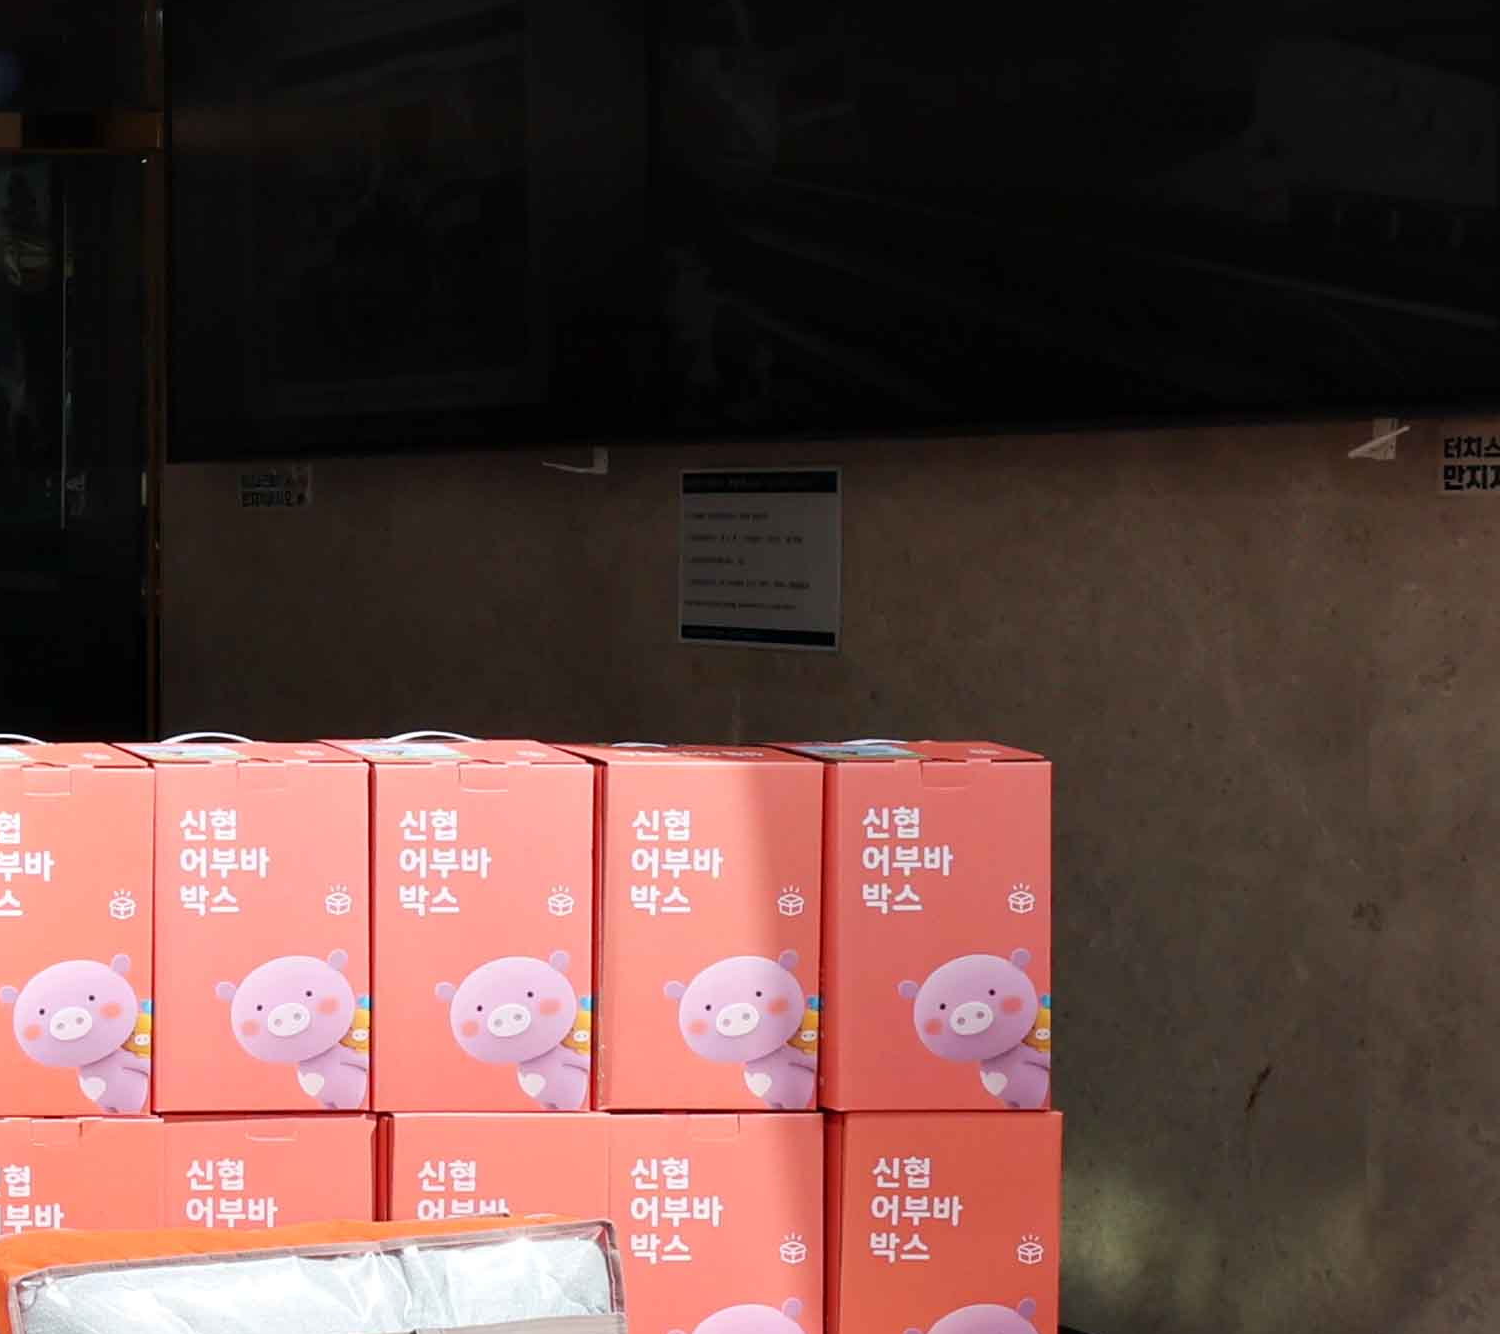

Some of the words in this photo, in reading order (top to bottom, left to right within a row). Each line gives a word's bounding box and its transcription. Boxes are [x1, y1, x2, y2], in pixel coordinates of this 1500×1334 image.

[400, 809, 457, 840] 신협
[863, 807, 919, 838] 신협
[400, 848, 491, 878] 어부바
[863, 845, 953, 876] 어부바
[400, 886, 460, 916] 박스
[863, 884, 922, 914] 박스
[873, 1157, 930, 1188] 신협
[871, 1195, 963, 1226] 어부바
[870, 1233, 929, 1263] 박스
